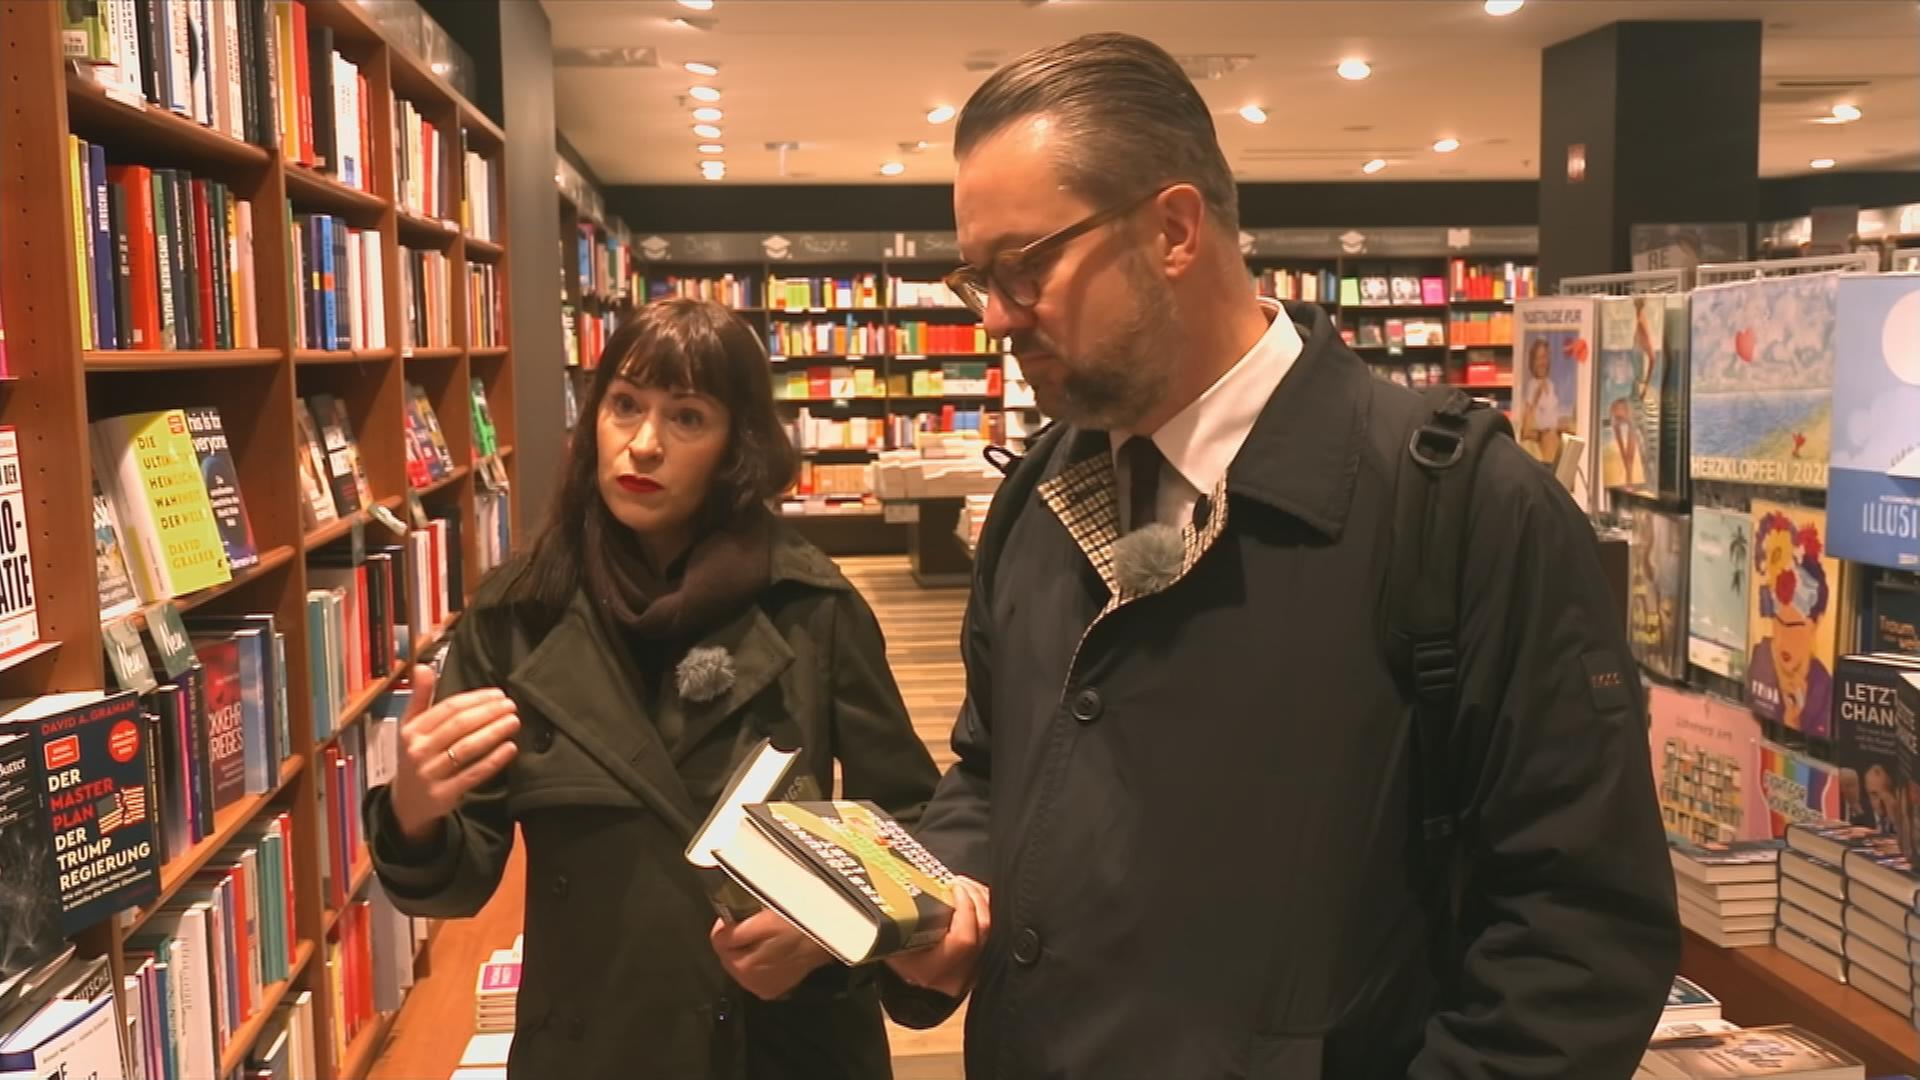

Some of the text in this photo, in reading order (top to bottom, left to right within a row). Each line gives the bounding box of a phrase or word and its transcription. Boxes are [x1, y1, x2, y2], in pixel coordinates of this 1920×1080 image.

[1690, 455, 1829, 485] HERZKLOPFEN 202
[41, 717, 77, 736] DAVID
[1841, 701, 1898, 729] CHAN
[48, 768, 82, 793] DER
[50, 777, 114, 812] MASTER
[53, 803, 96, 832] PLAN
[55, 827, 87, 852] DER
[56, 837, 112, 871] TRUMP
[60, 842, 151, 892] REGIERUNG
